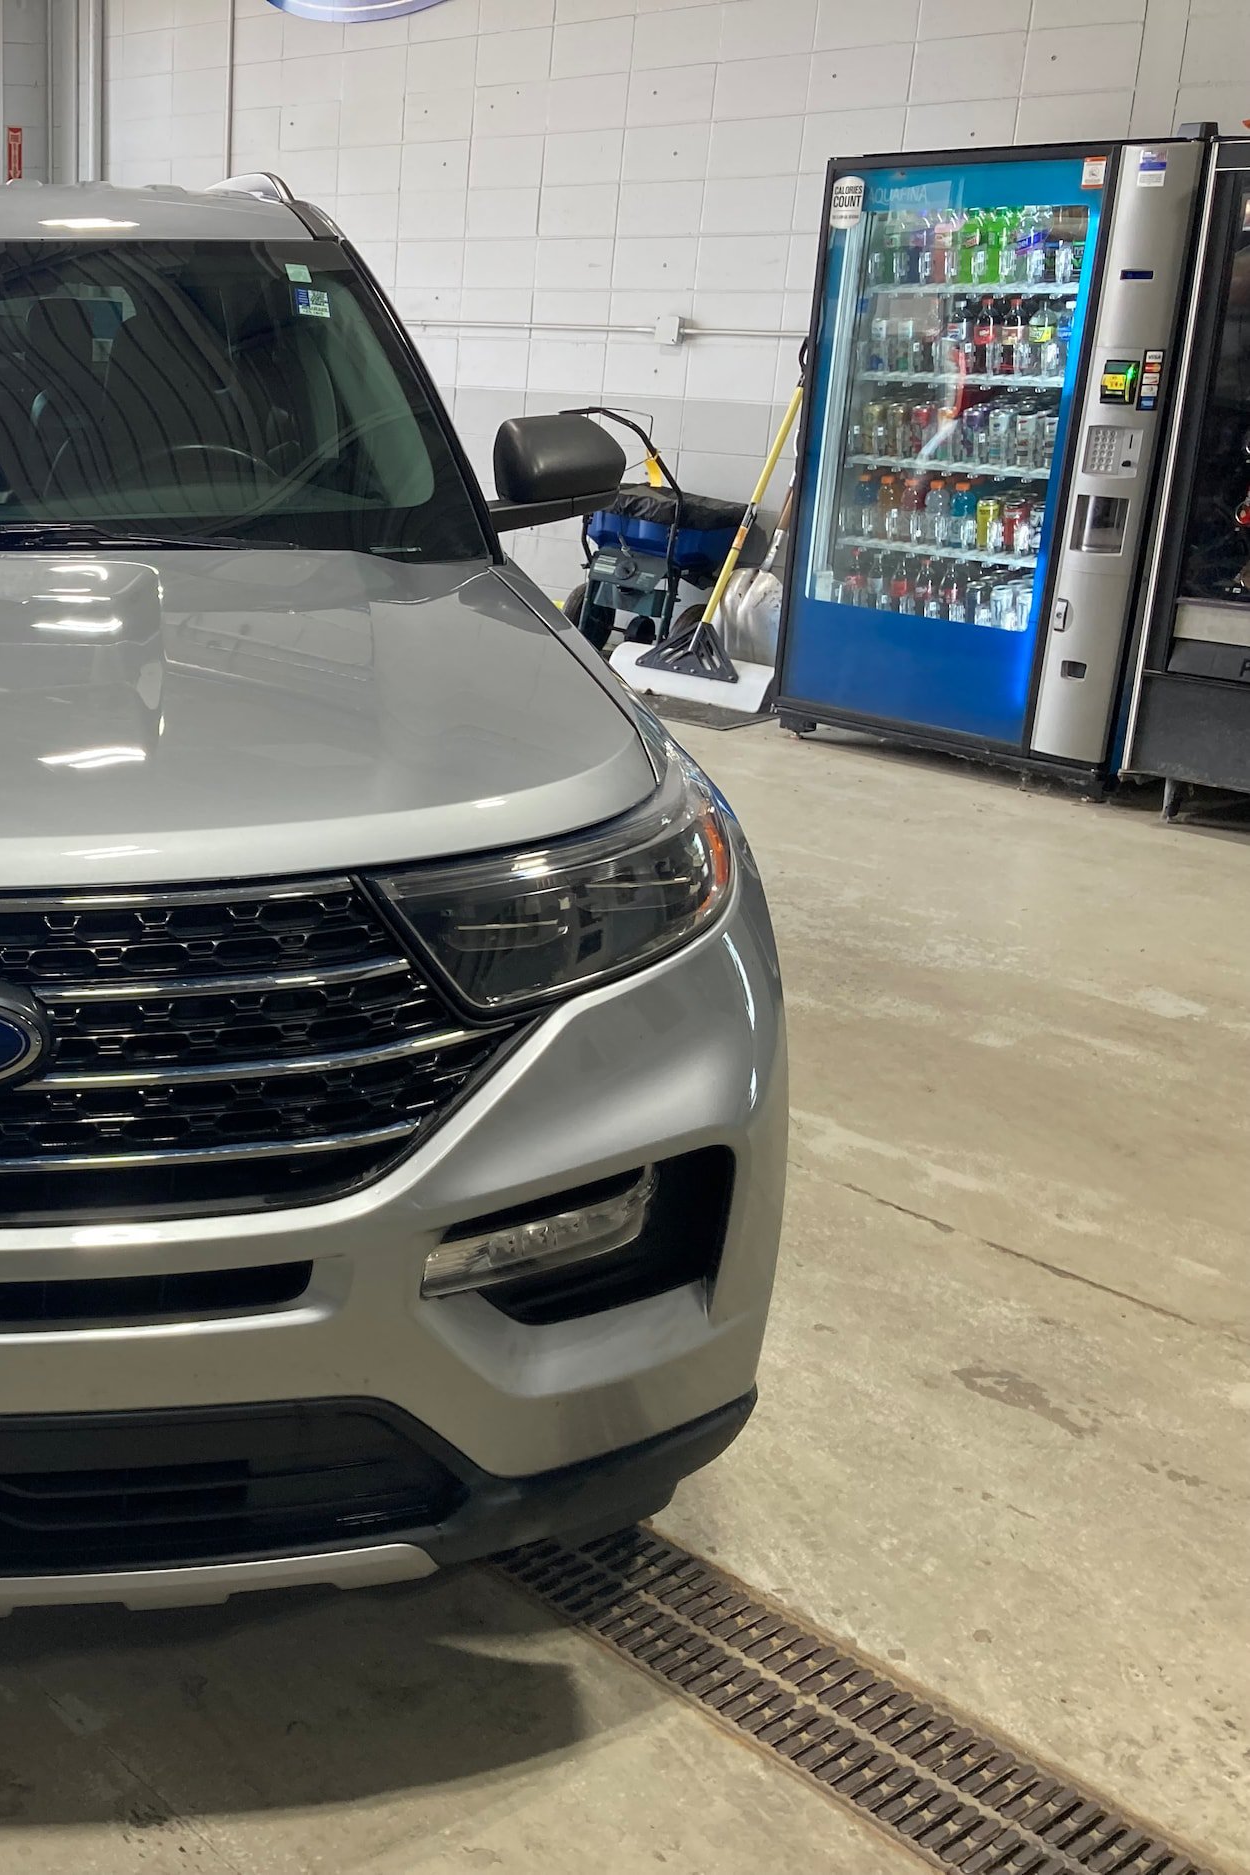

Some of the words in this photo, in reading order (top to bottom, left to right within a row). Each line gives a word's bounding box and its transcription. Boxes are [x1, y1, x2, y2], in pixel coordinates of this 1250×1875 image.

[834, 185, 863, 195] CALORIES
[868, 185, 928, 205] AQUAFINA
[833, 195, 862, 208] COUNT
